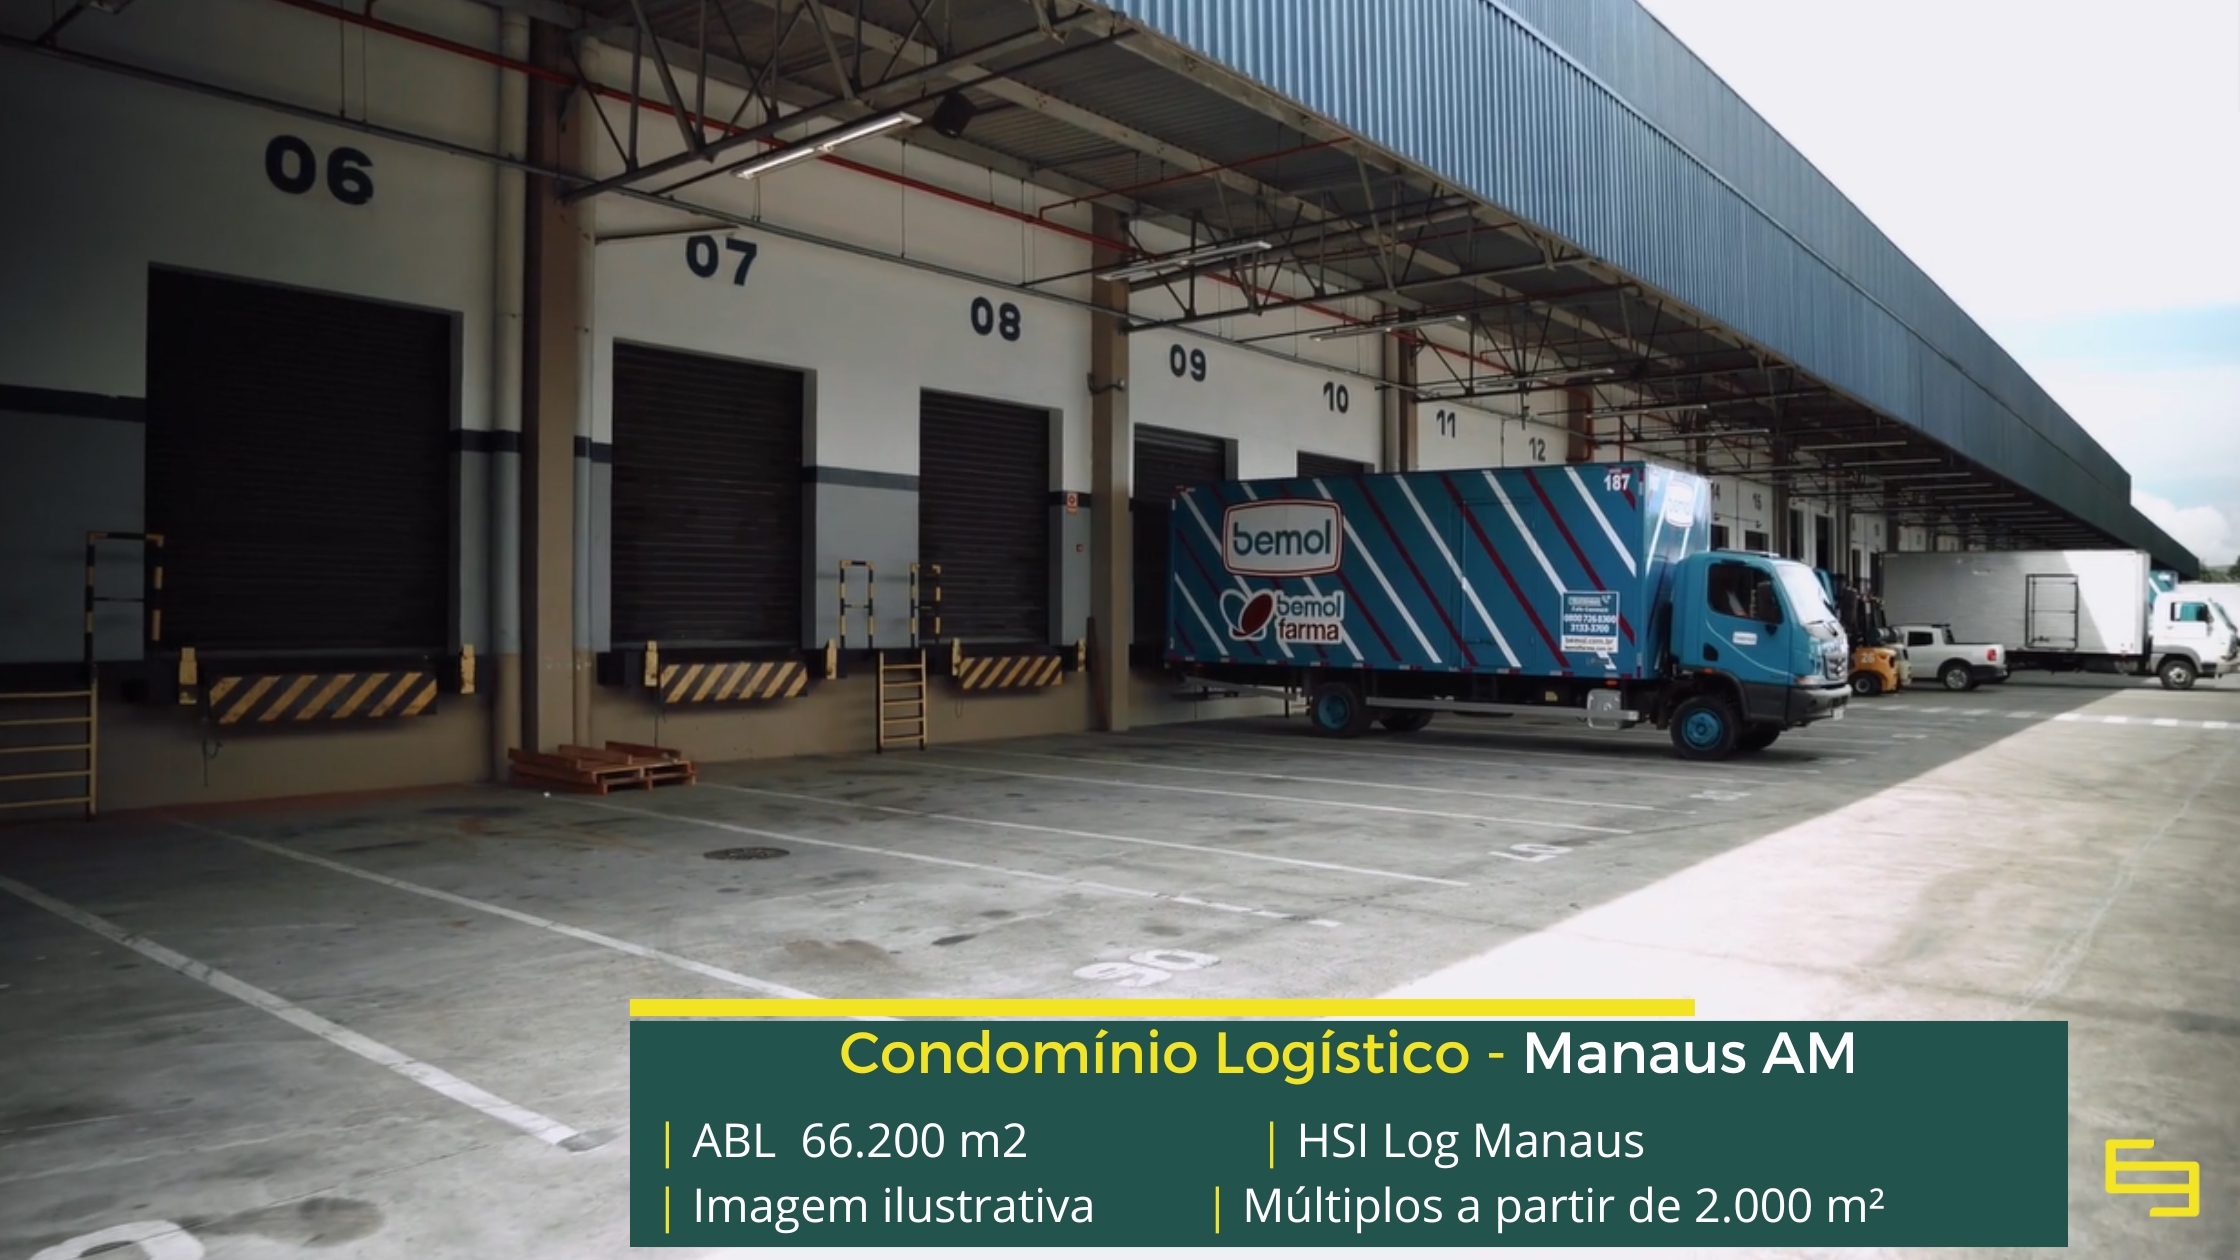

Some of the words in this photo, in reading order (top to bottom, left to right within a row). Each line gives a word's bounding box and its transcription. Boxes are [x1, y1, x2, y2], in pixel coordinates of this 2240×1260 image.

[265, 135, 374, 206] 06
[686, 234, 758, 287] 07
[970, 297, 1021, 342] 08
[1169, 343, 1207, 382] 09
[1323, 381, 1349, 414] 10
[1436, 409, 1456, 439] 11
[1528, 436, 1546, 463] 12
[1603, 474, 1631, 491] 187
[1232, 519, 1332, 557] bemol
[1277, 594, 1341, 617] bemol
[1279, 618, 1340, 641] farma
